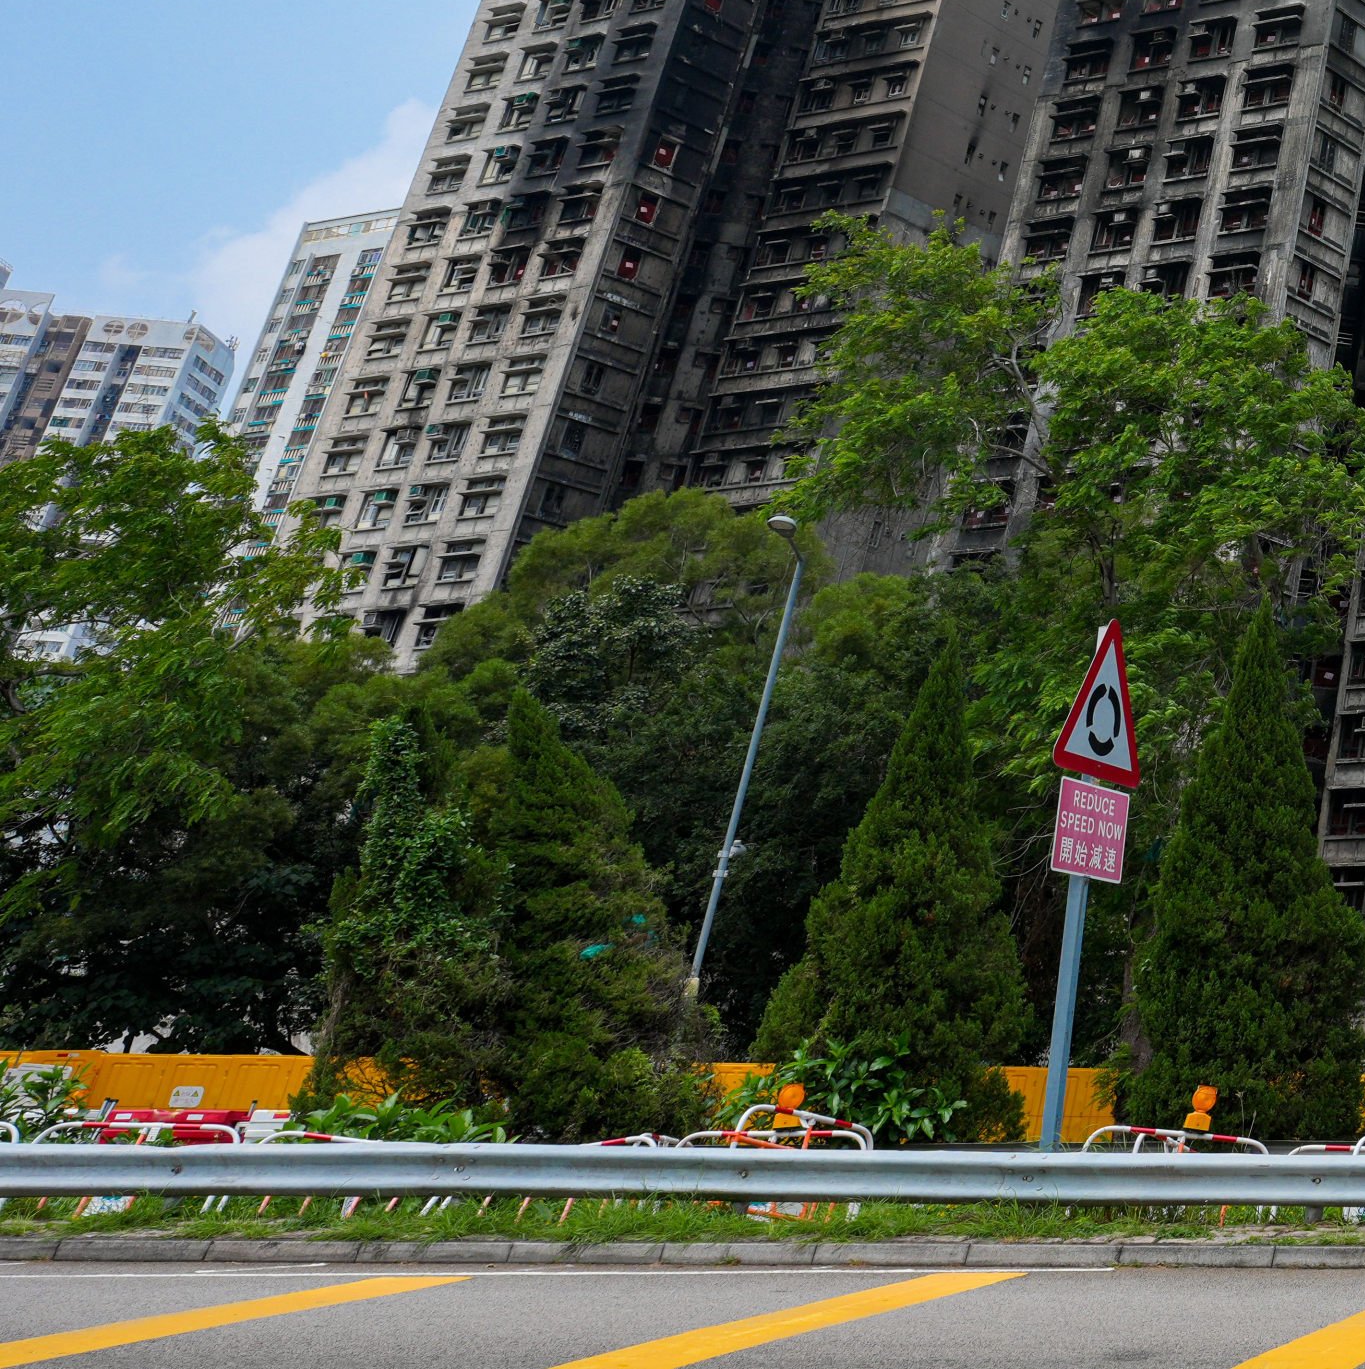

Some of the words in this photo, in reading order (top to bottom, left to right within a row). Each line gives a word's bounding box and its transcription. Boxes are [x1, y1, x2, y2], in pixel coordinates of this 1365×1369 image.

[1073, 790, 1115, 816] REDUCE
[1060, 811, 1095, 834] SPEED
[1097, 820, 1123, 840] NOW
[1059, 836, 1117, 872] 開始減速
